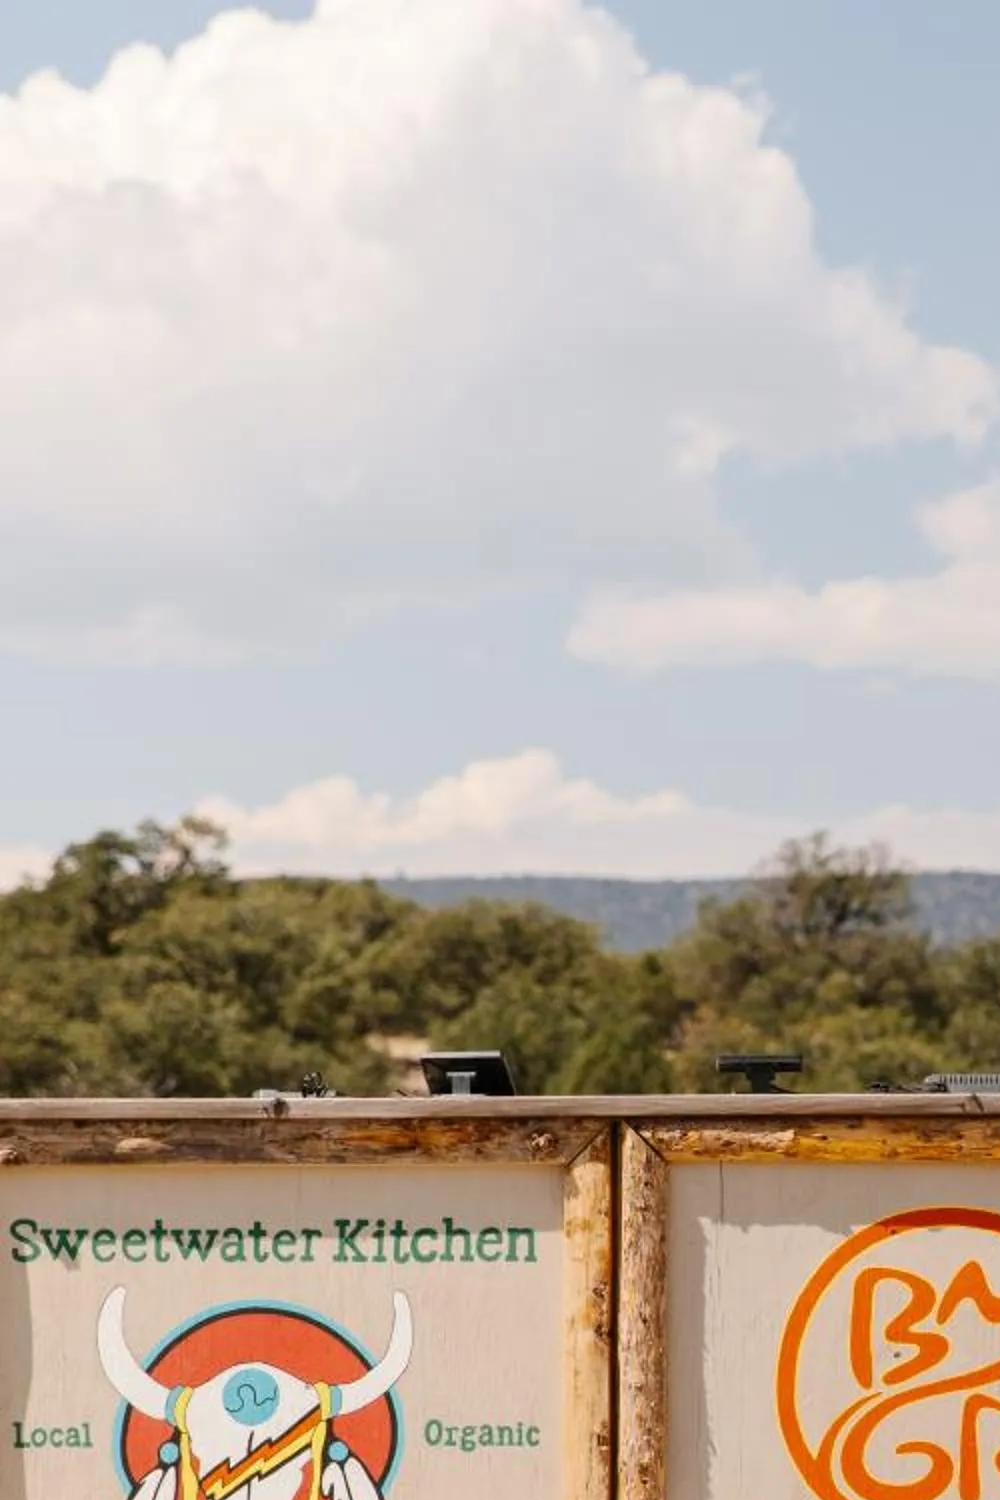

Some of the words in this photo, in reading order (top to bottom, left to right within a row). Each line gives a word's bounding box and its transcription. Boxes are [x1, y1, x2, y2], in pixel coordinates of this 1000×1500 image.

[9, 1219, 323, 1264] Sweetwater
[332, 1217, 538, 1264] Kitchen
[13, 1421, 93, 1449] Local
[424, 1419, 541, 1452] Organic
